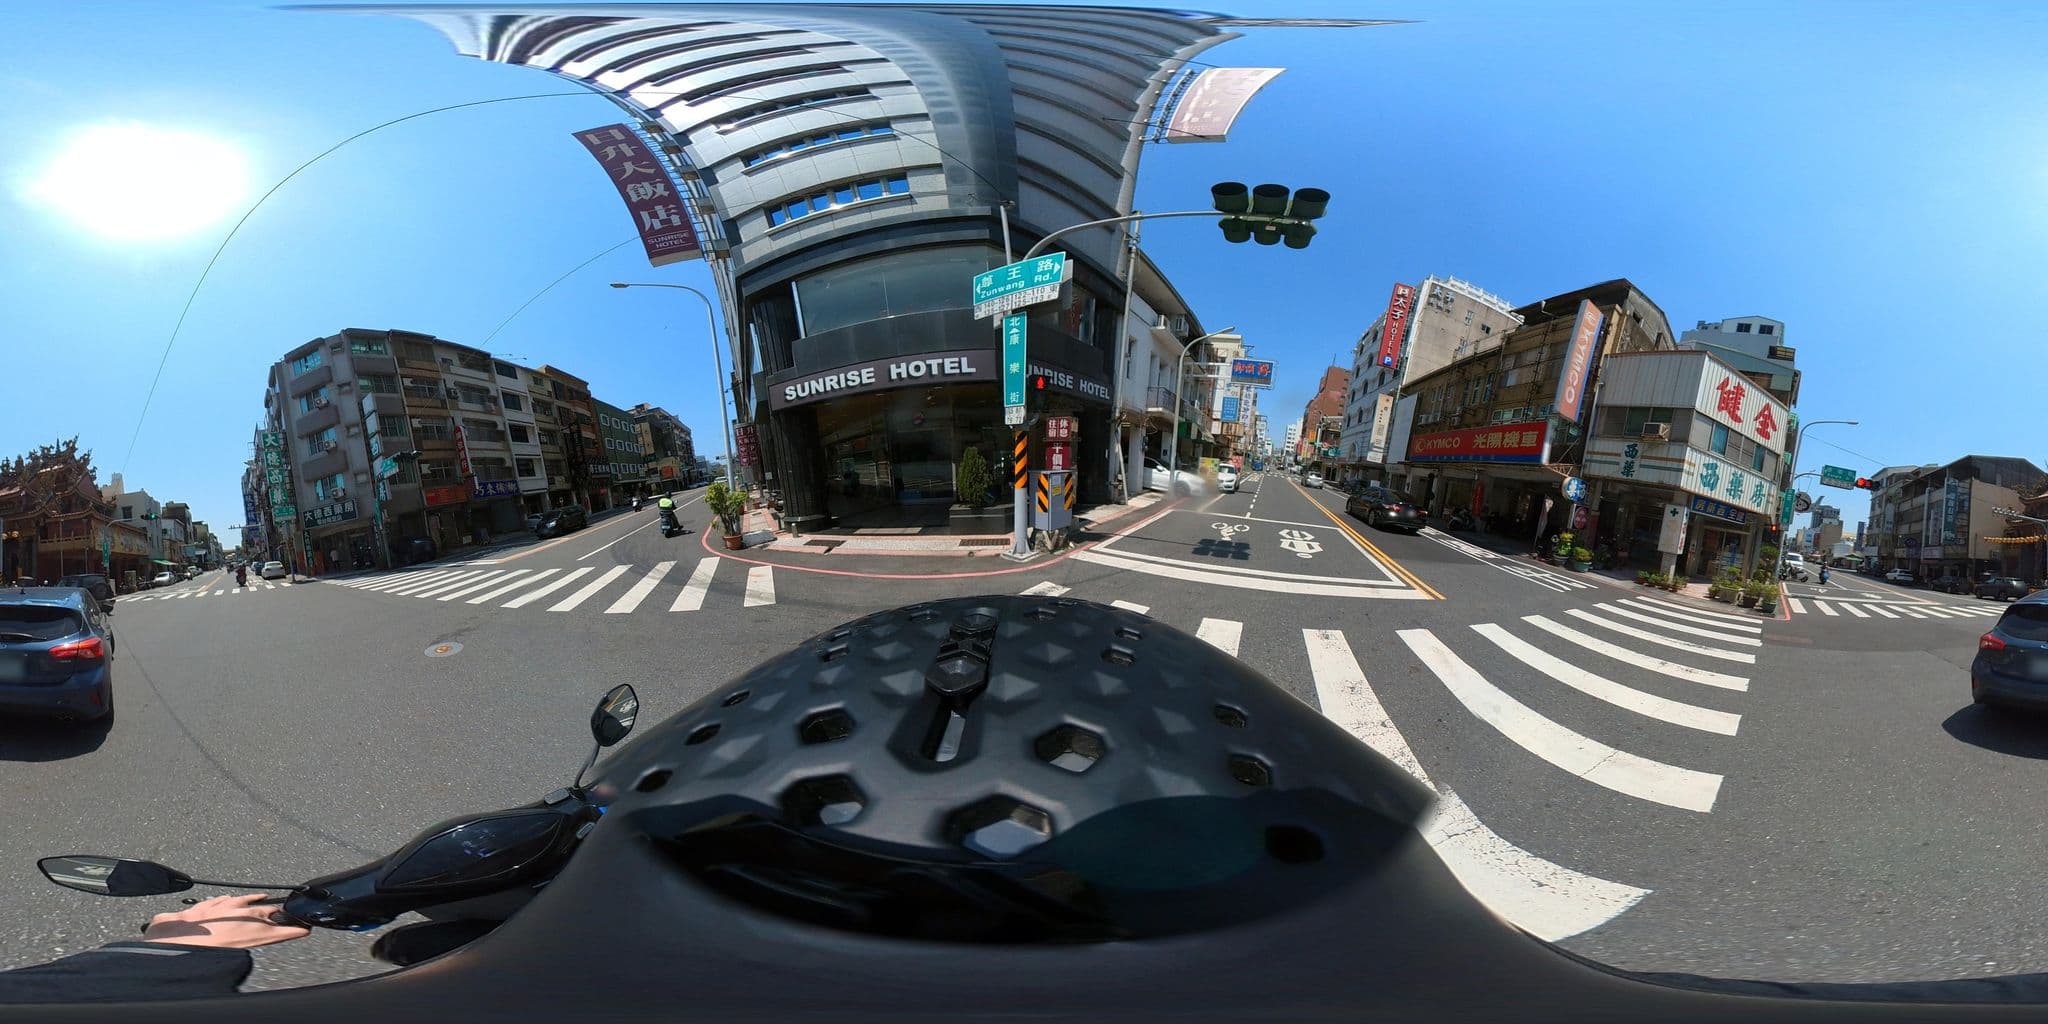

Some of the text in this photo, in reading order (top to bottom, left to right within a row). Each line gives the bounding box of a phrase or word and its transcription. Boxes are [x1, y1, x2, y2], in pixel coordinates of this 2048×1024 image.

[585, 129, 682, 232] 日升大飯店
[648, 232, 689, 244] SUNRISE
[655, 239, 686, 248] HOTEL
[980, 273, 1053, 298] Zunwang Rd.
[981, 259, 1053, 288] 尊王路
[1009, 317, 1020, 327] 北
[1392, 299, 1410, 320] 太子
[1387, 322, 1399, 355] HOTEL
[784, 356, 977, 401] SUNRISE HOTEL
[1009, 334, 1020, 403] 康樂街
[1566, 329, 1597, 404] KYMCO
[1080, 379, 1110, 400] HOTEL
[1716, 376, 1778, 441] 健全
[1426, 436, 1461, 450] KYMCO
[1472, 431, 1539, 449] 光陽機車
[1621, 443, 1639, 478] 西藥
[1700, 462, 1766, 507] 西藥房
[304, 500, 355, 522] 大德西藥房
